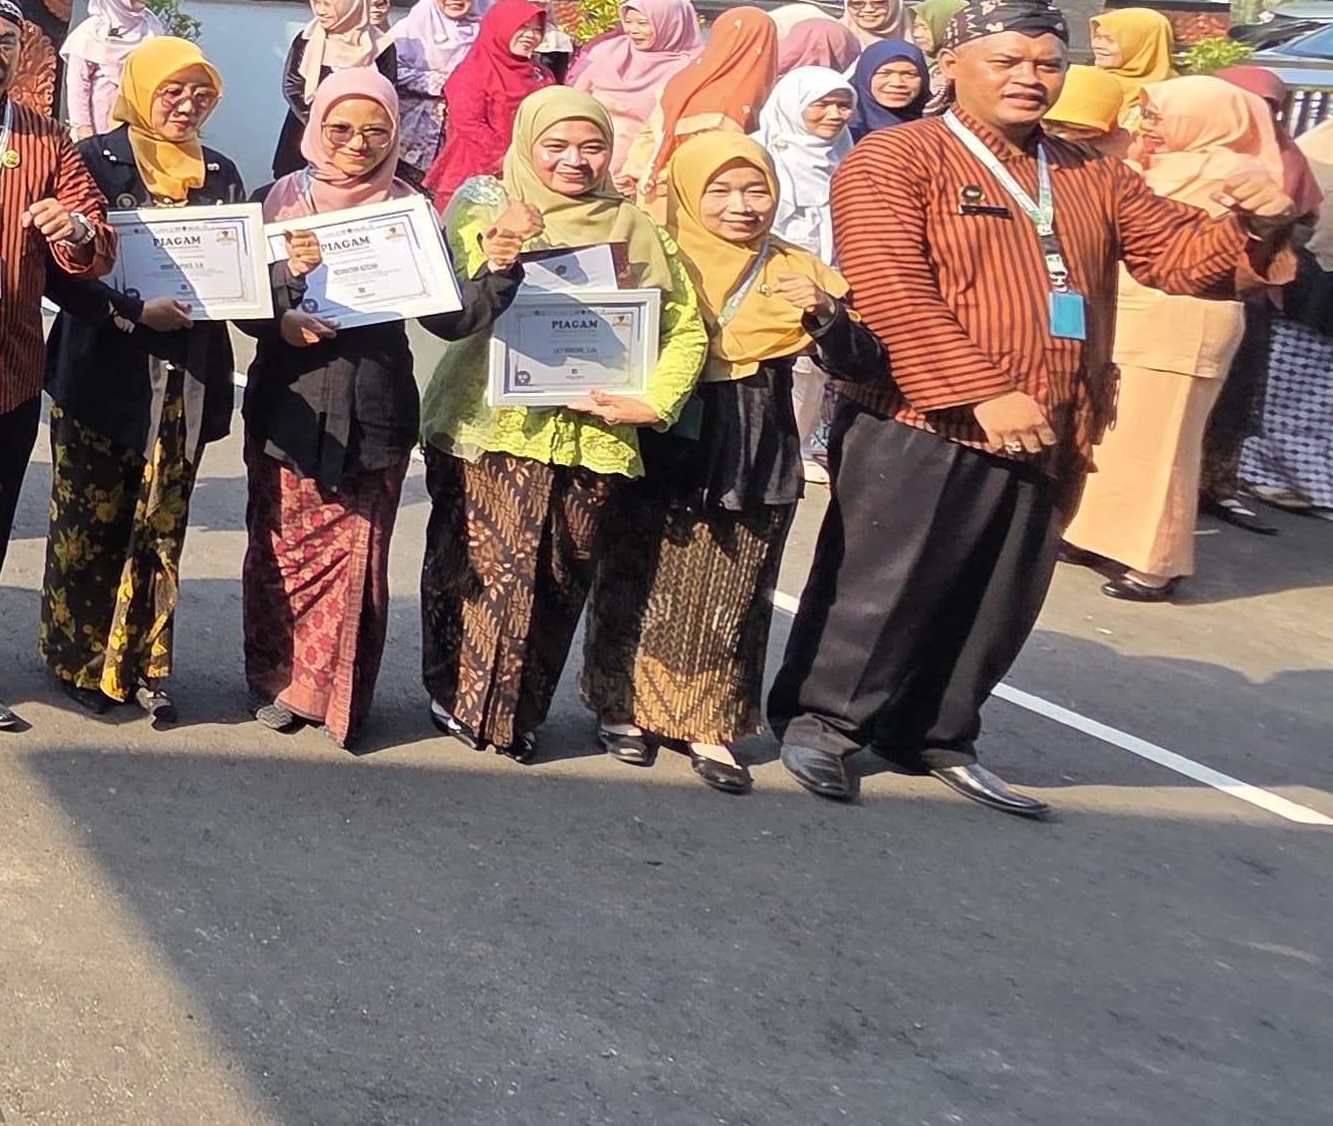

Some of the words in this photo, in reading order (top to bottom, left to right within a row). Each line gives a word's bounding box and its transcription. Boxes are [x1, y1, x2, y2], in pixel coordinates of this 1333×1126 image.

[152, 235, 202, 247] PIAGAM
[320, 235, 371, 252] PIAGAM
[551, 320, 599, 329] PIAGAM
